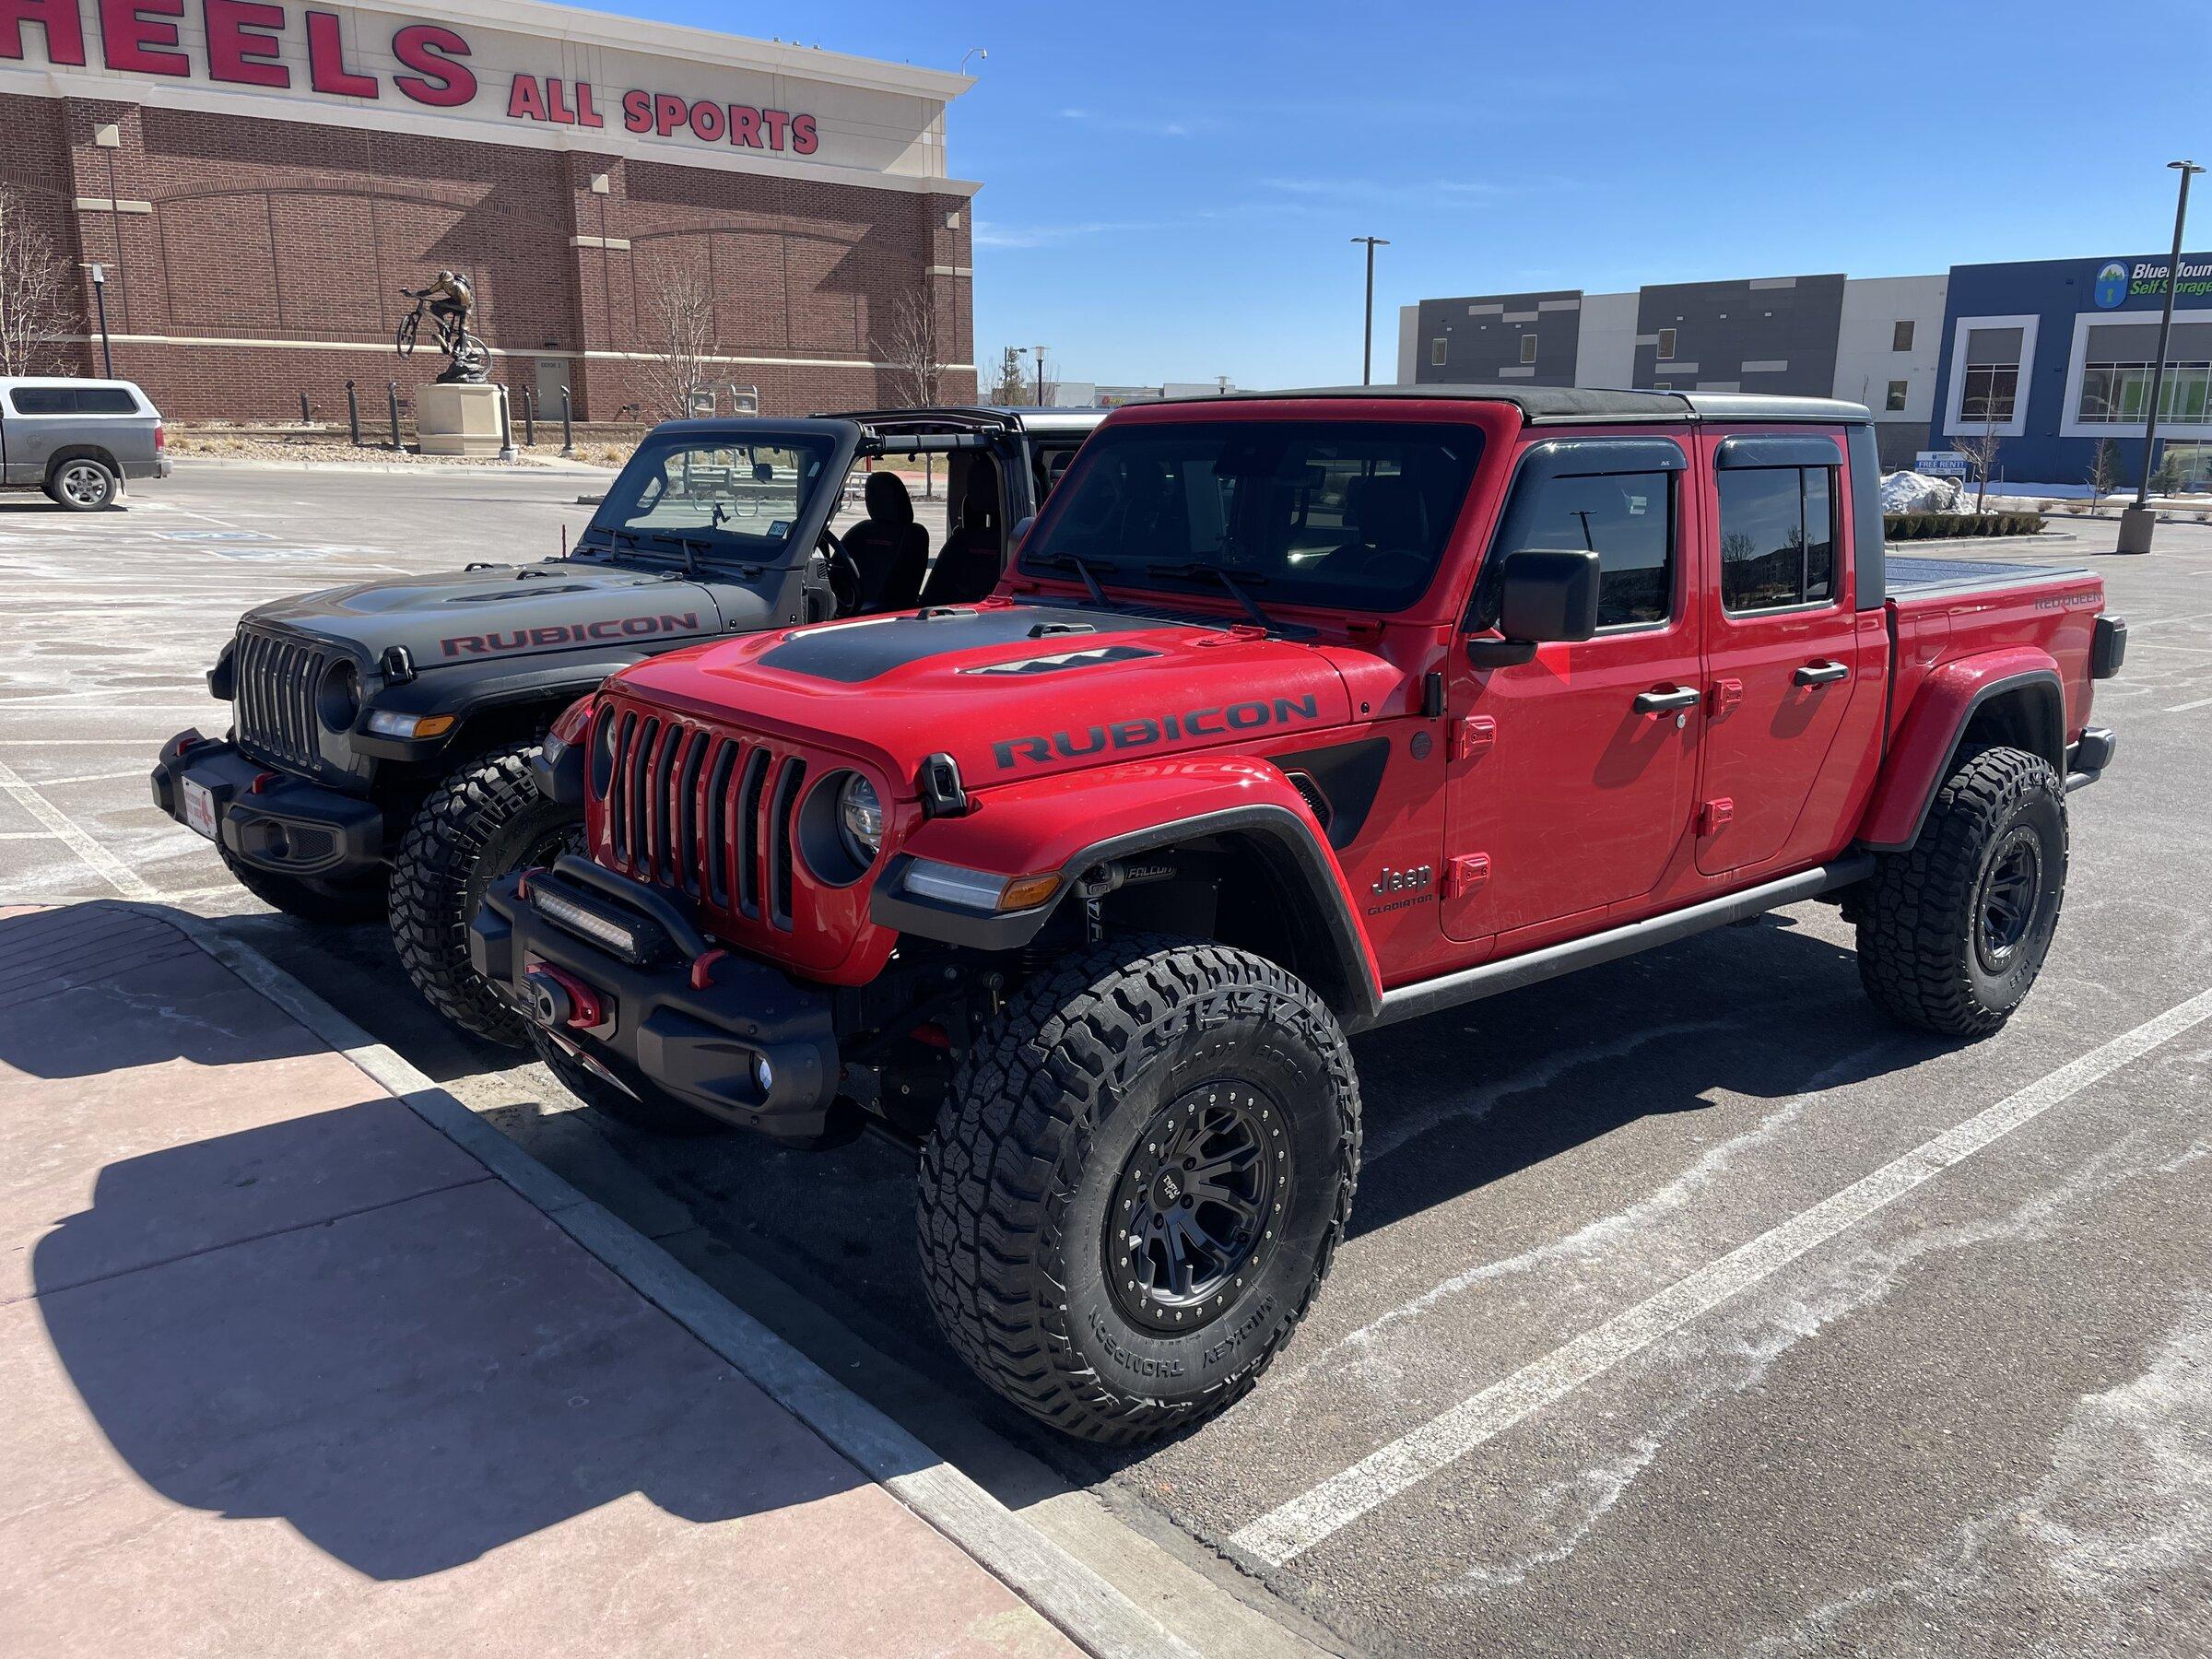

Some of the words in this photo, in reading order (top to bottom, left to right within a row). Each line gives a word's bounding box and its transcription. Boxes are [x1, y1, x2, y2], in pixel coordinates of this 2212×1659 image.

[507, 74, 604, 128] ALL
[622, 89, 818, 155] SPORTS
[2130, 279, 2160, 295] Self
[2160, 279, 2212, 296] Sorage
[2035, 596, 2061, 610] RED
[440, 611, 700, 657] RUBICON
[991, 694, 1320, 771] RUBICON
[1371, 865, 1431, 896] Jeep
[1367, 894, 1433, 916] GLADIATOR
[1088, 1303, 1185, 1379] THOMPSON
[1202, 1293, 1277, 1370] MICKEY
